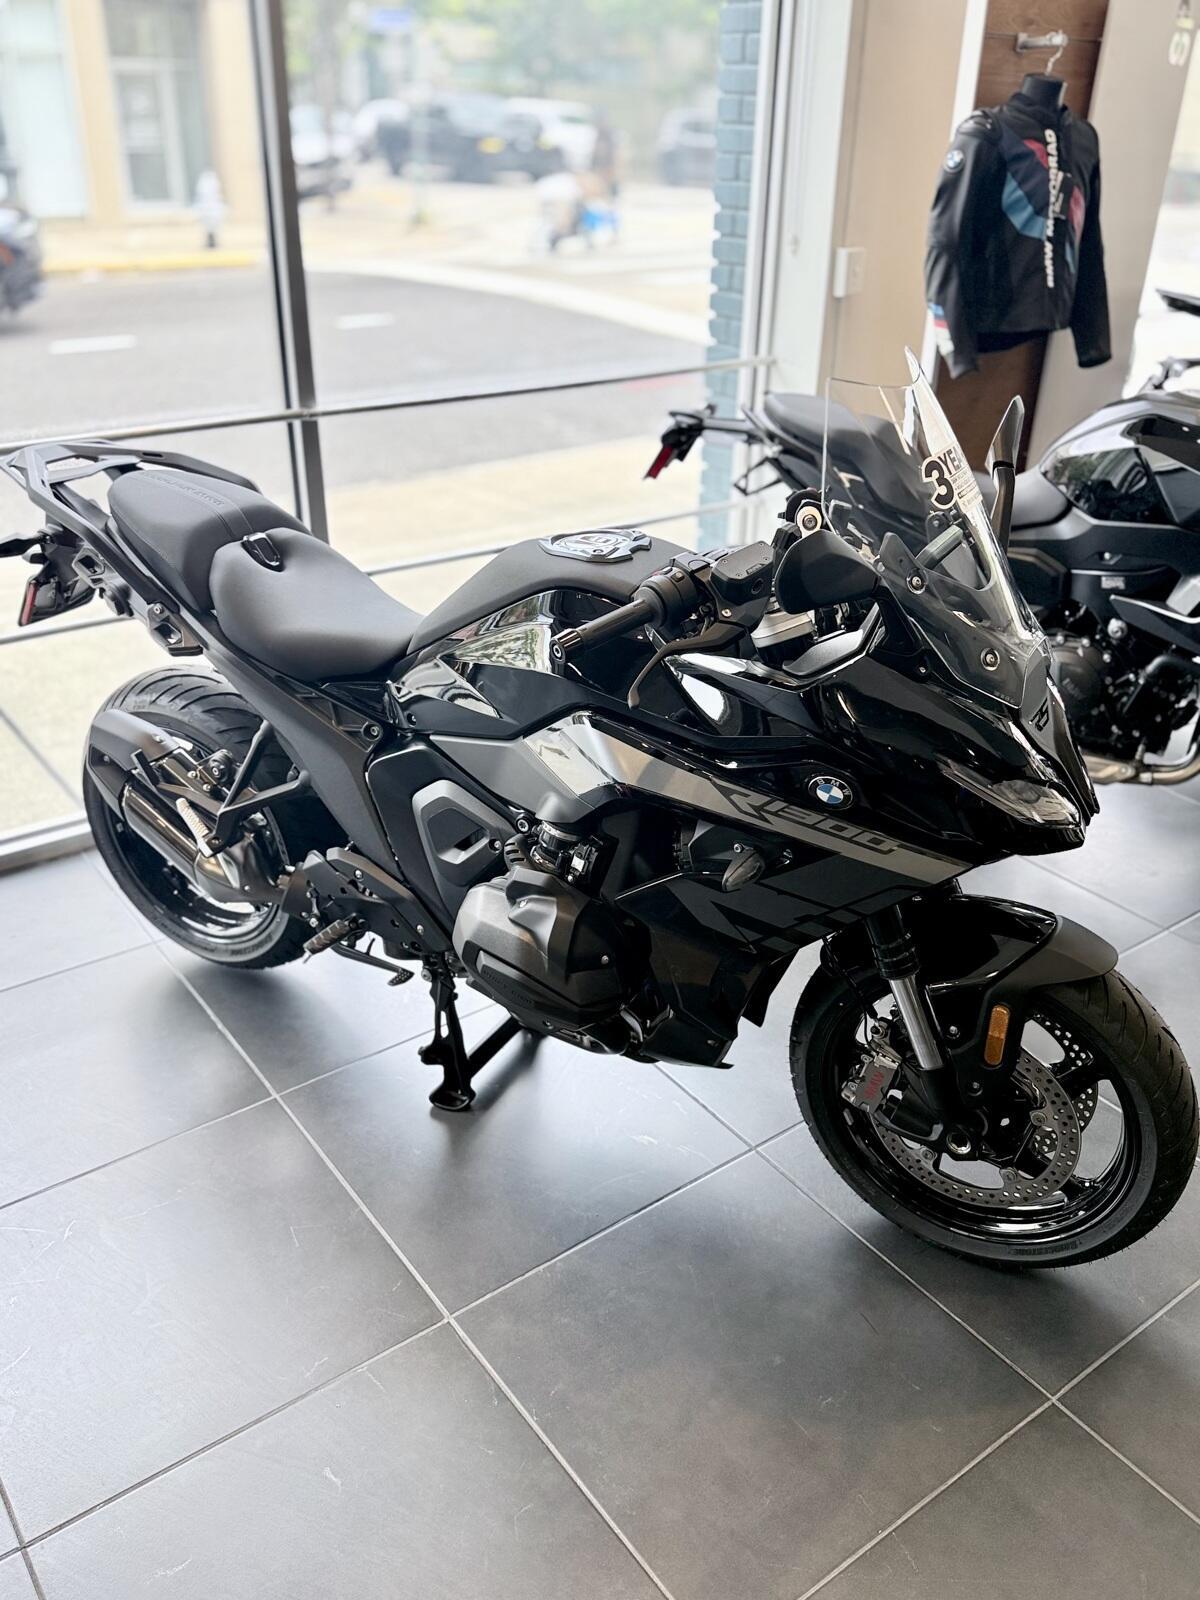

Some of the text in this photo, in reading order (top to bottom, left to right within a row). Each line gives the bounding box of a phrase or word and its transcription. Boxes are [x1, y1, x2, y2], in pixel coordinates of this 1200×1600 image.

[1044, 240, 1055, 288] BMW
[924, 460, 955, 506] 3
[816, 778, 851, 796] BMW
